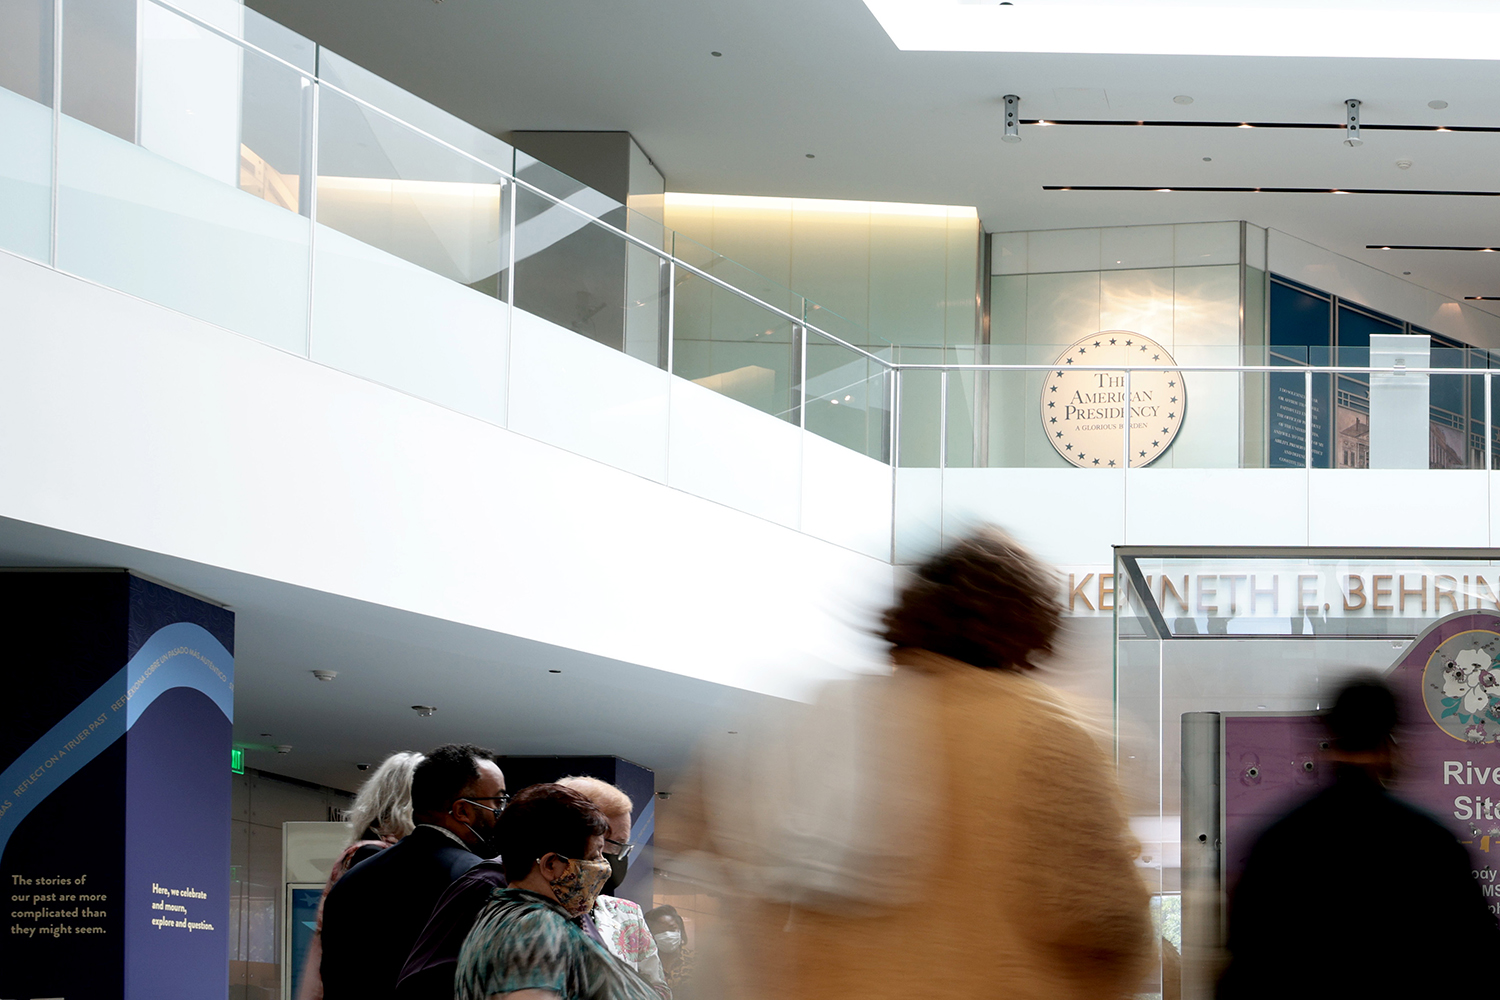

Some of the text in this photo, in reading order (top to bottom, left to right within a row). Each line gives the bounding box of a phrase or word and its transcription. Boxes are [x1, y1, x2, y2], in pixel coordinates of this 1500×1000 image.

[1081, 423, 1117, 431] GLORIOUS
[1118, 422, 1148, 430] BRDEN
[1297, 574, 1330, 612] E.
[110, 675, 146, 712] REFLEXIONA
[144, 659, 161, 679] SOBRE
[13, 712, 108, 797] REFLECT ON A TRUER PAST
[11, 874, 87, 885] The stories of
[1471, 867, 1497, 882] ody
[152, 882, 170, 898] Here,
[180, 887, 207, 900] celebrate
[33, 893, 56, 905] past
[11, 907, 107, 922] complicated than
[151, 899, 188, 915] and mourn,
[11, 923, 107, 938] they might seem.
[151, 915, 215, 932] explore and question.
